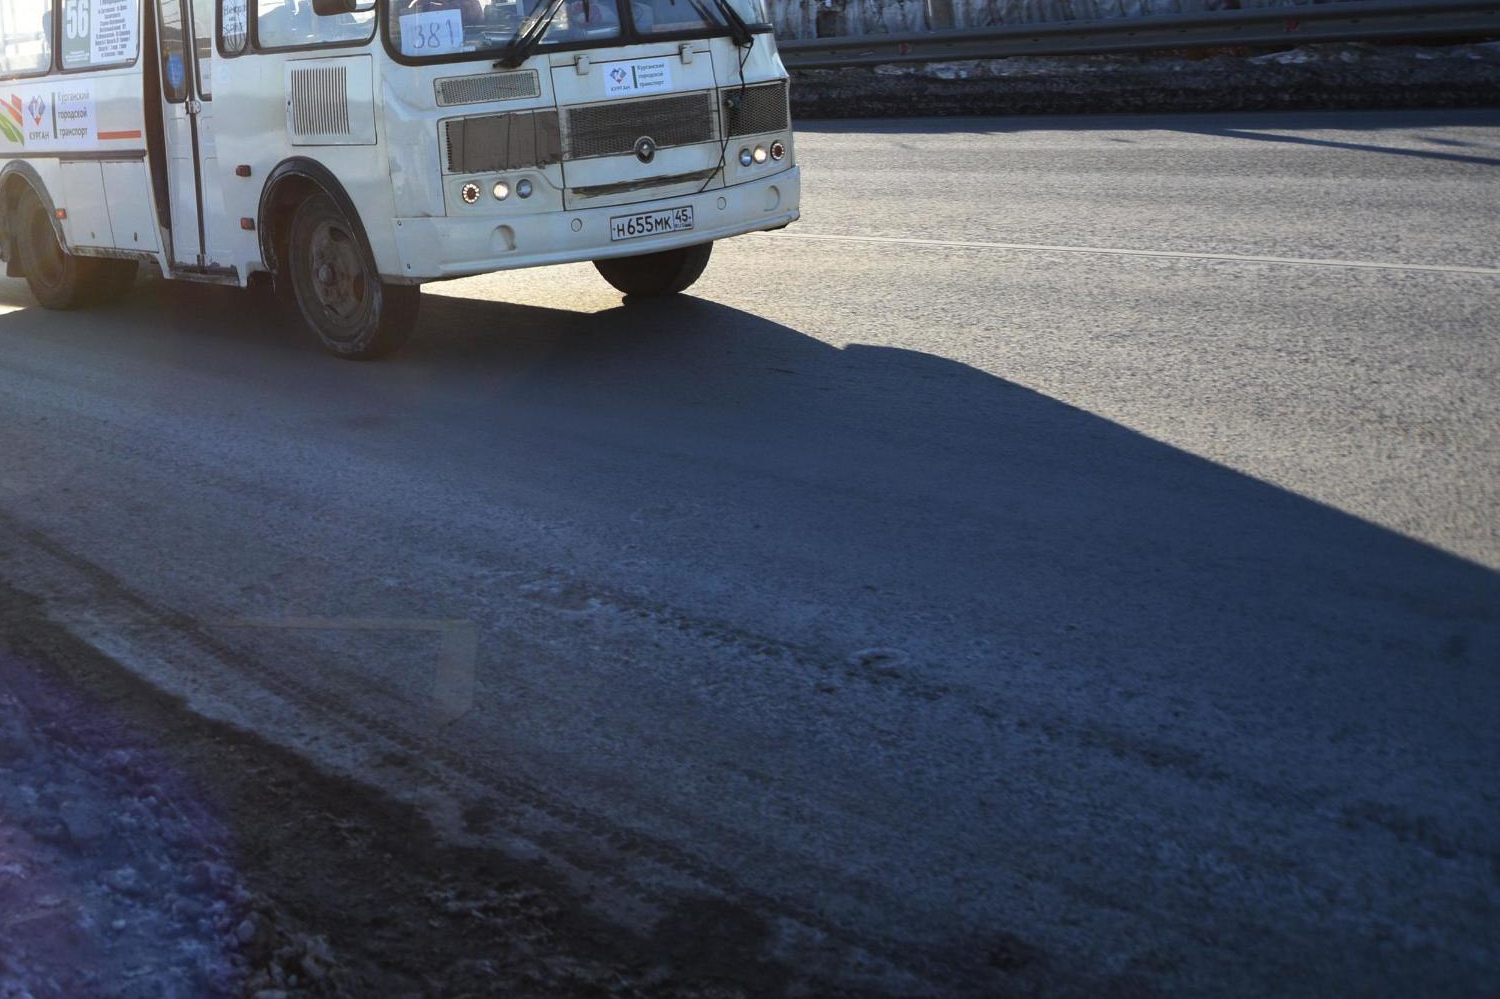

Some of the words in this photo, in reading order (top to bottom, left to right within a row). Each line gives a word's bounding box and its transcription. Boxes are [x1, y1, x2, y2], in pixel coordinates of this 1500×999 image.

[413, 19, 454, 49] 381
[58, 90, 89, 104] Курганский
[58, 106, 88, 121] городской
[29, 131, 49, 141] КУРГАН
[60, 128, 88, 139] транспорт
[616, 215, 671, 237] Н655МК
[675, 209, 688, 223] 45
